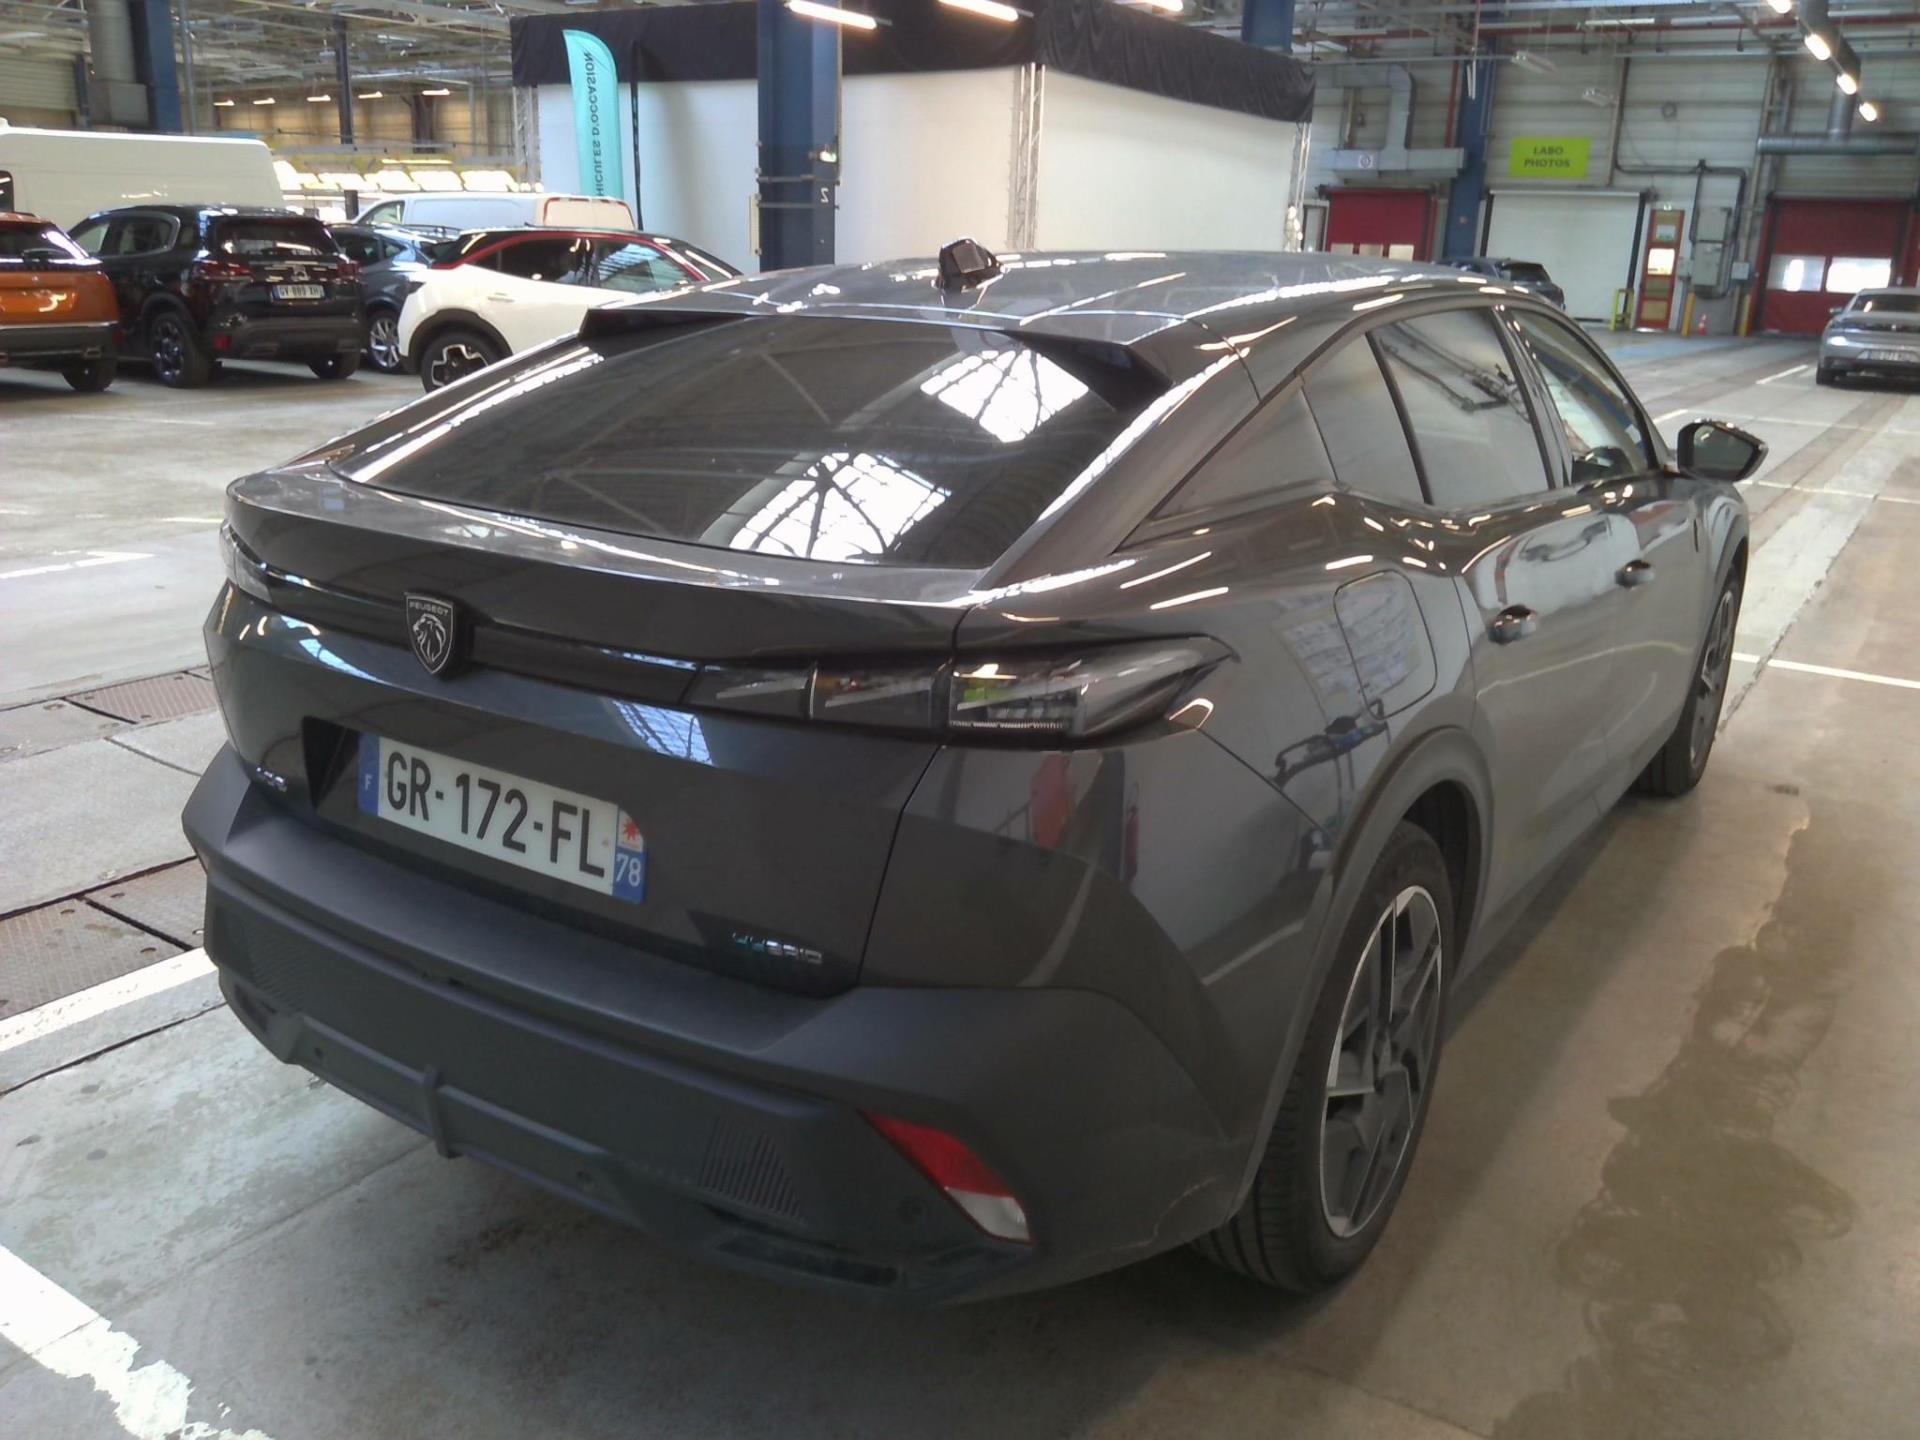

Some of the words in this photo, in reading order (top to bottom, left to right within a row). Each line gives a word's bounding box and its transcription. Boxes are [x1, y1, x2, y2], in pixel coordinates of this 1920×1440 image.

[1533, 145, 1564, 155] LABO
[1524, 158, 1571, 168] PHOTOS
[409, 601, 449, 616] PEUGEOT
[364, 775, 373, 791] F
[387, 751, 605, 878] GR-172-FL
[615, 853, 642, 887] 78
